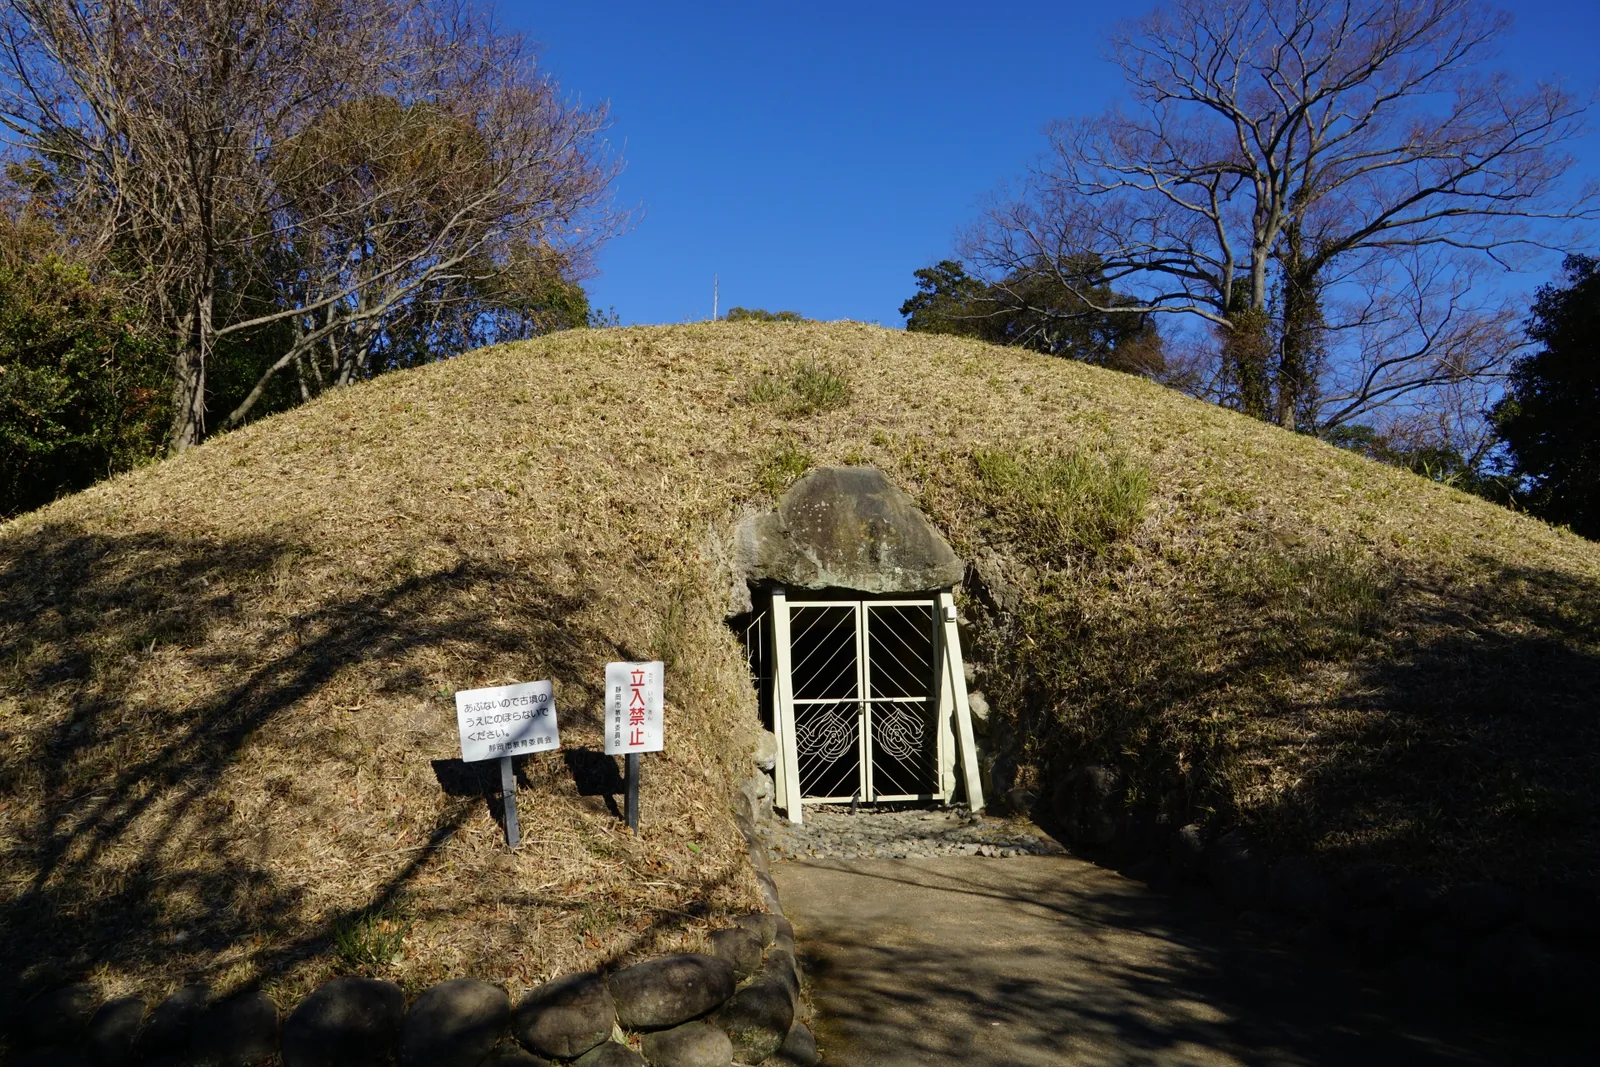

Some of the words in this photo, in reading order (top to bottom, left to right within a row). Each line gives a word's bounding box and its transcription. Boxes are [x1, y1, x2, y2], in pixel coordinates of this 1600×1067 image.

[464, 693, 547, 713] あぶないので古墳の
[629, 669, 645, 746] 立入禁止
[466, 707, 549, 728] うえにのぼらないで
[468, 729, 510, 742] ください。
